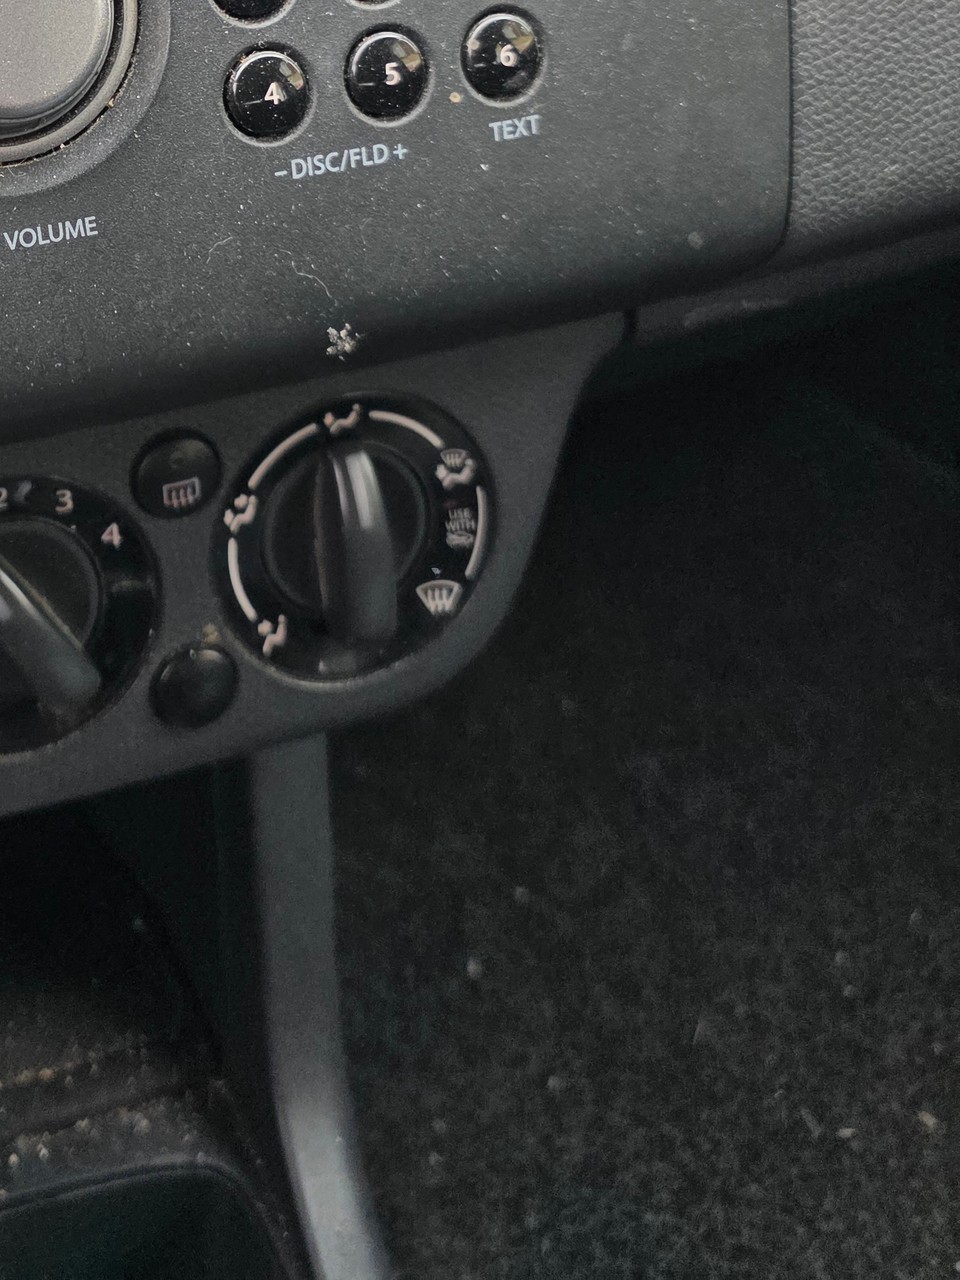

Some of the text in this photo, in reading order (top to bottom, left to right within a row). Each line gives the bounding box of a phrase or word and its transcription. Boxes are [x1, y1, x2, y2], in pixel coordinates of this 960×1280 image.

[499, 43, 517, 67] 6
[384, 62, 400, 86] 5
[264, 81, 280, 104] 4
[489, 114, 540, 141] TEXT
[3, 216, 98, 250] VOLUME
[55, 489, 74, 513] 3
[101, 522, 122, 548] 4
[445, 519, 475, 531] WITH
[448, 507, 471, 519] USE
